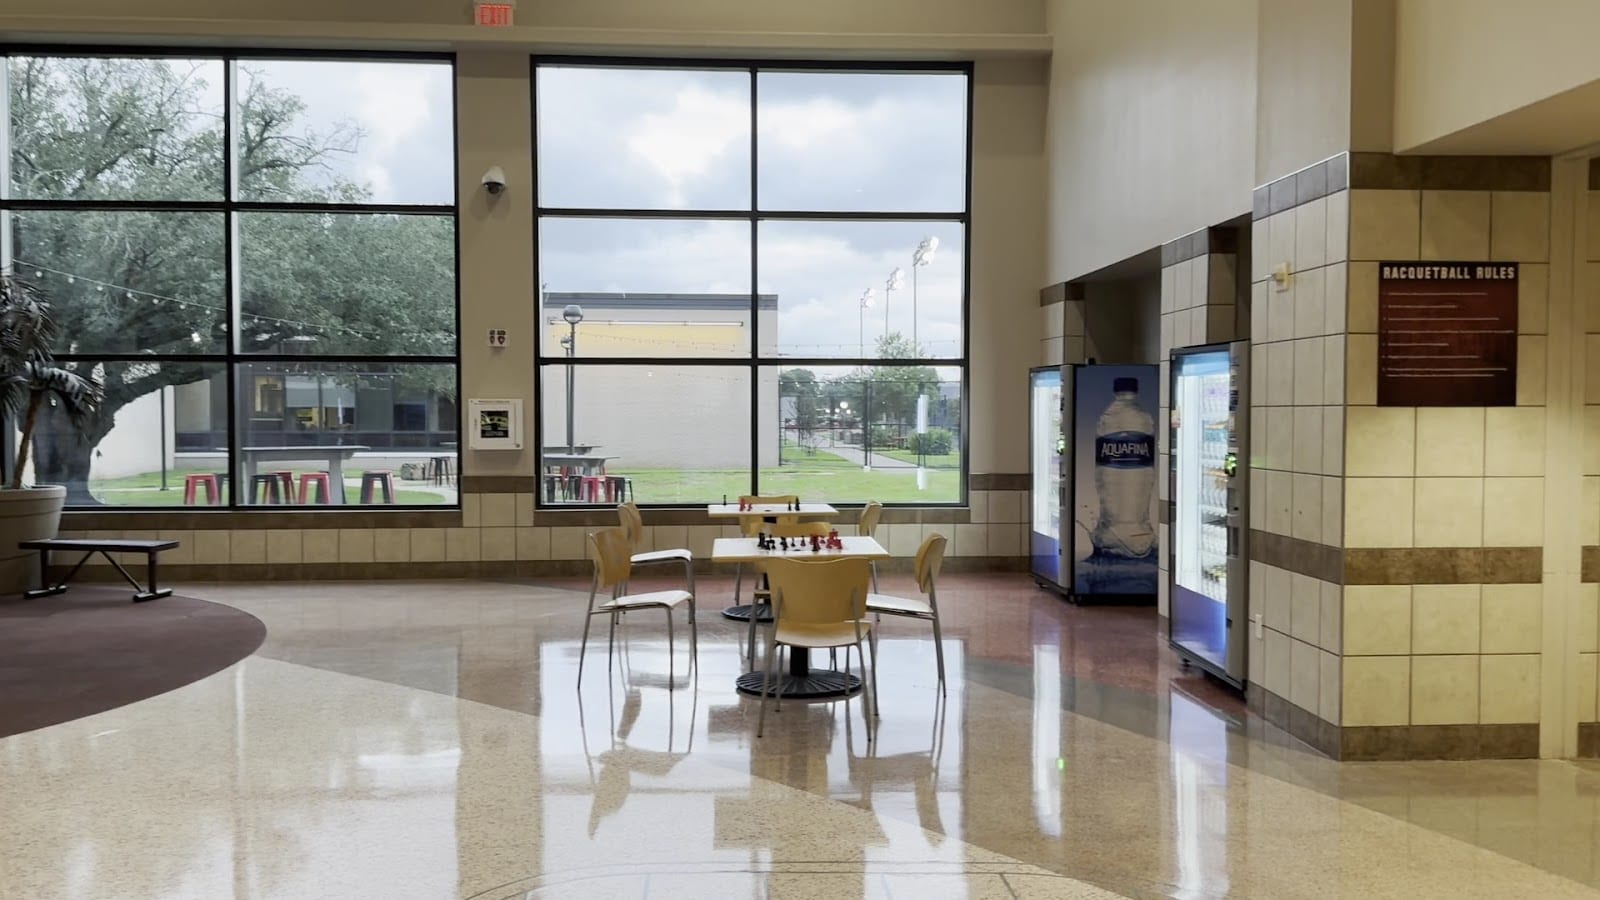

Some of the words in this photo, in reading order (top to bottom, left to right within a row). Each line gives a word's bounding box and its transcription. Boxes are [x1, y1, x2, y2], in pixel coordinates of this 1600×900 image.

[480, 6, 510, 25] EXIT
[1383, 266, 1471, 279] RACQUETBALL
[1476, 266, 1515, 279] RULES
[1100, 442, 1150, 457] AQUAFINA
